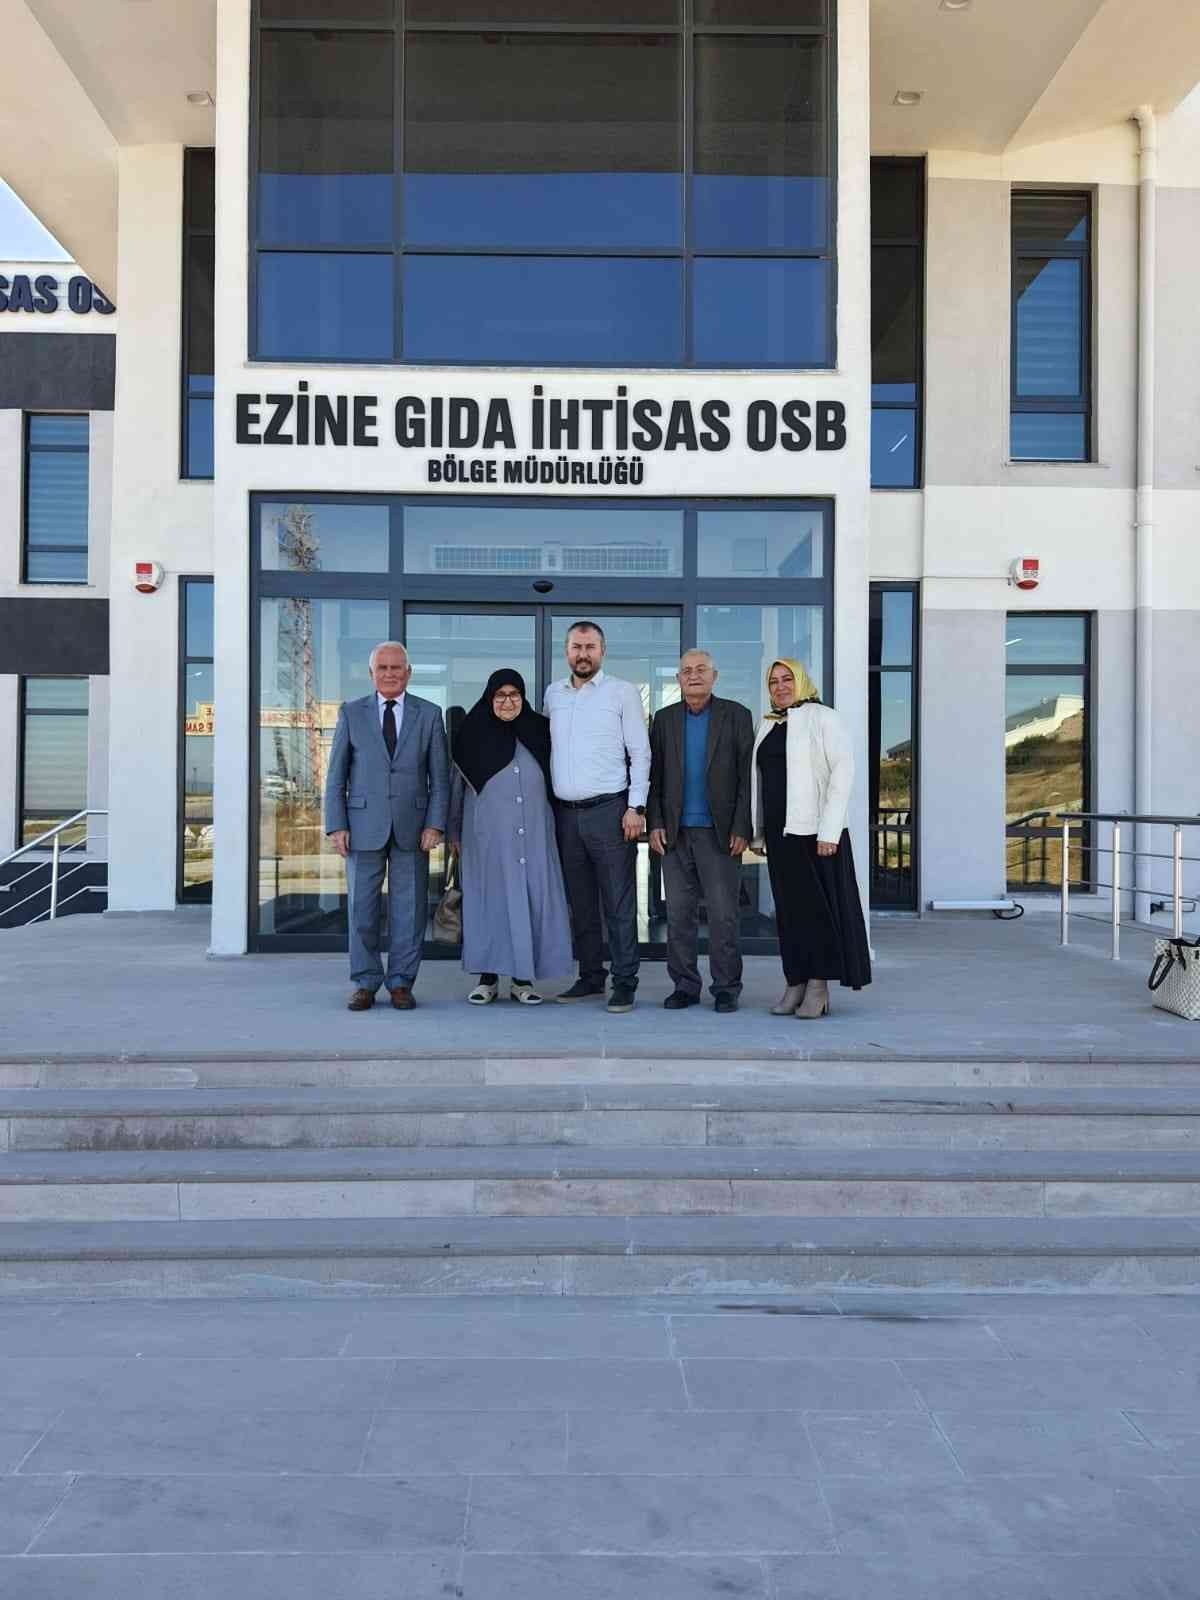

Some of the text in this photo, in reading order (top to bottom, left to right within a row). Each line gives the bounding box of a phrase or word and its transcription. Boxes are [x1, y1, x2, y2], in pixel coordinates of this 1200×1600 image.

[236, 381, 847, 451] EZİNE GIDA İHTİSAS OSB
[428, 453, 644, 485] BÖLGE MÜDÜRLÜĞÜ
